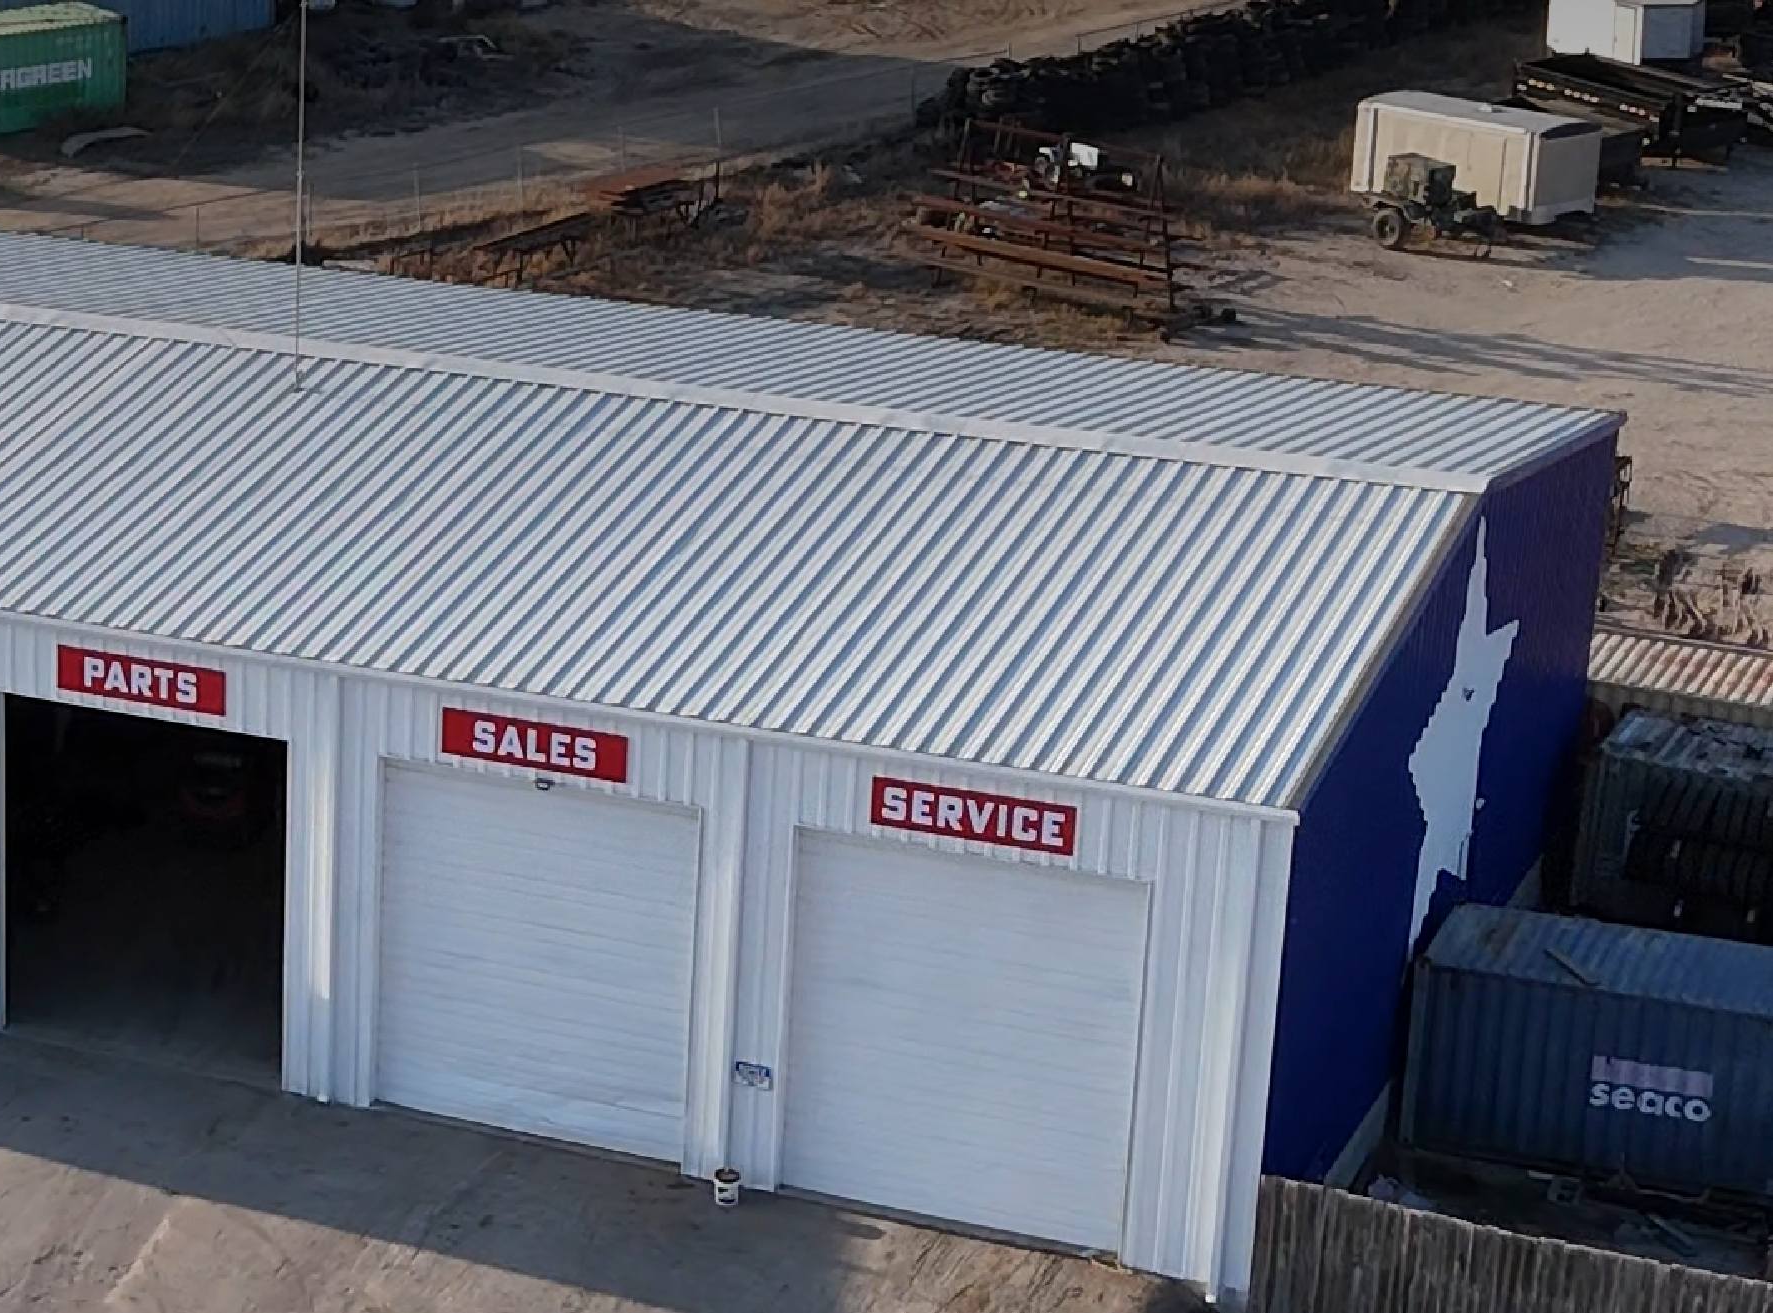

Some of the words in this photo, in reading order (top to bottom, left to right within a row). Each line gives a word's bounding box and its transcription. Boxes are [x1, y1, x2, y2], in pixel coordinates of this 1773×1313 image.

[83, 656, 198, 704] PARTS
[472, 719, 597, 771] SALES
[881, 786, 1067, 847] SERVICE
[1589, 1083, 1712, 1122] seaco
